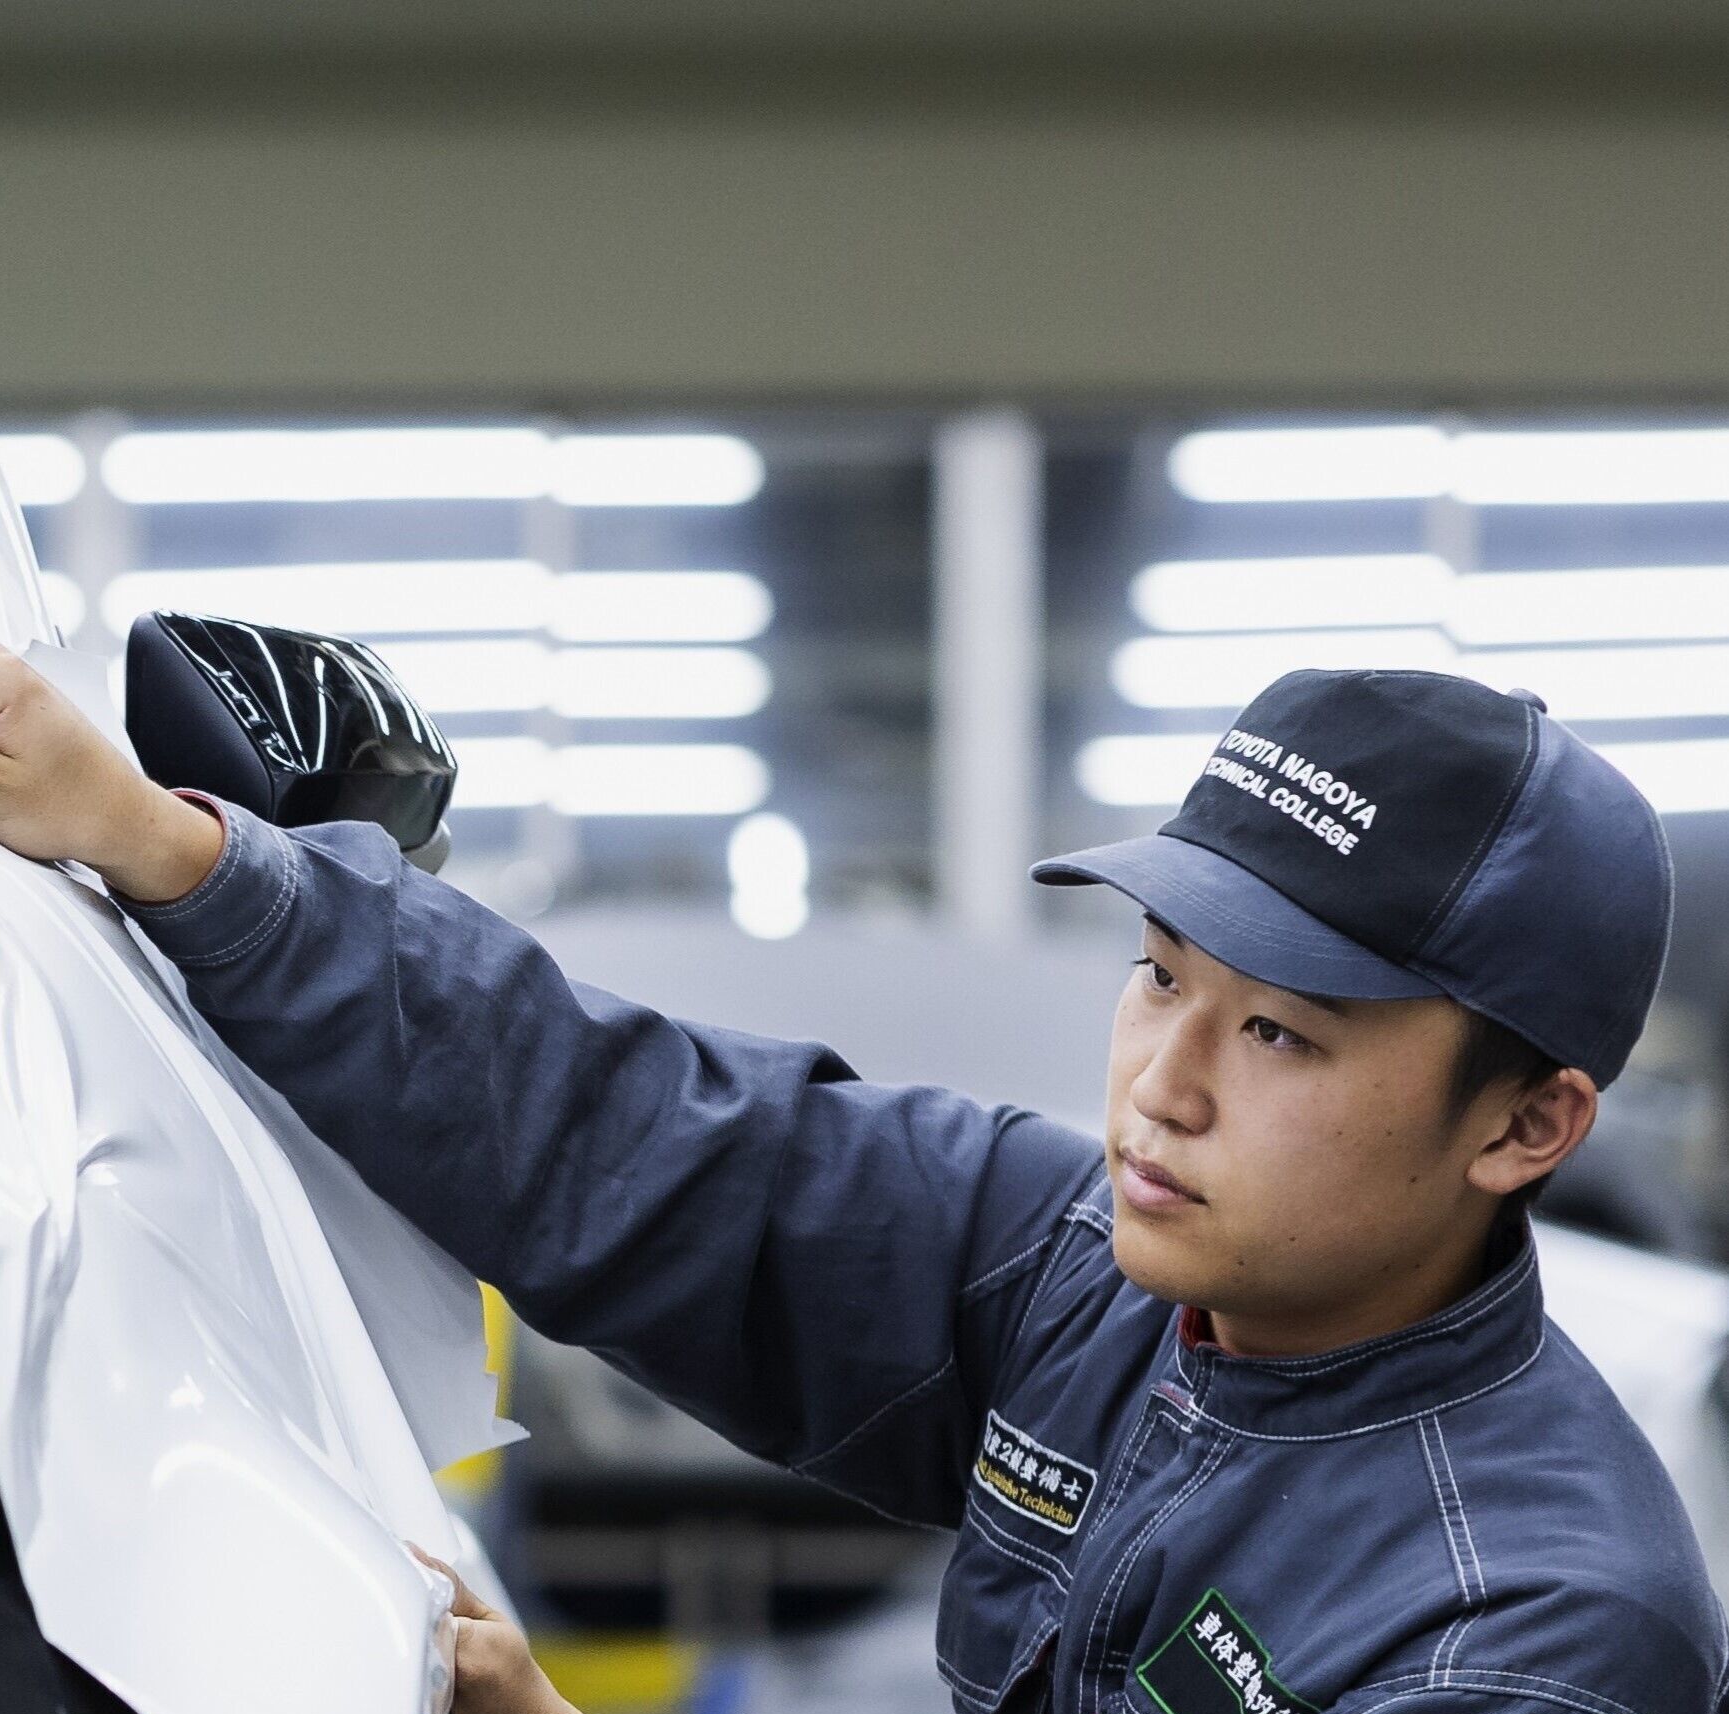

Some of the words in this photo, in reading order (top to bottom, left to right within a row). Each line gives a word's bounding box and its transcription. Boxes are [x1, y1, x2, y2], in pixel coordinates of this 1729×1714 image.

[1203, 756, 1270, 799] ECHNICAL
[1268, 787, 1360, 856] COLLEGE
[1221, 729, 1284, 769] TOYOTA
[1278, 753, 1378, 830] NAGOYA
[1019, 1487, 1074, 1525] Technician
